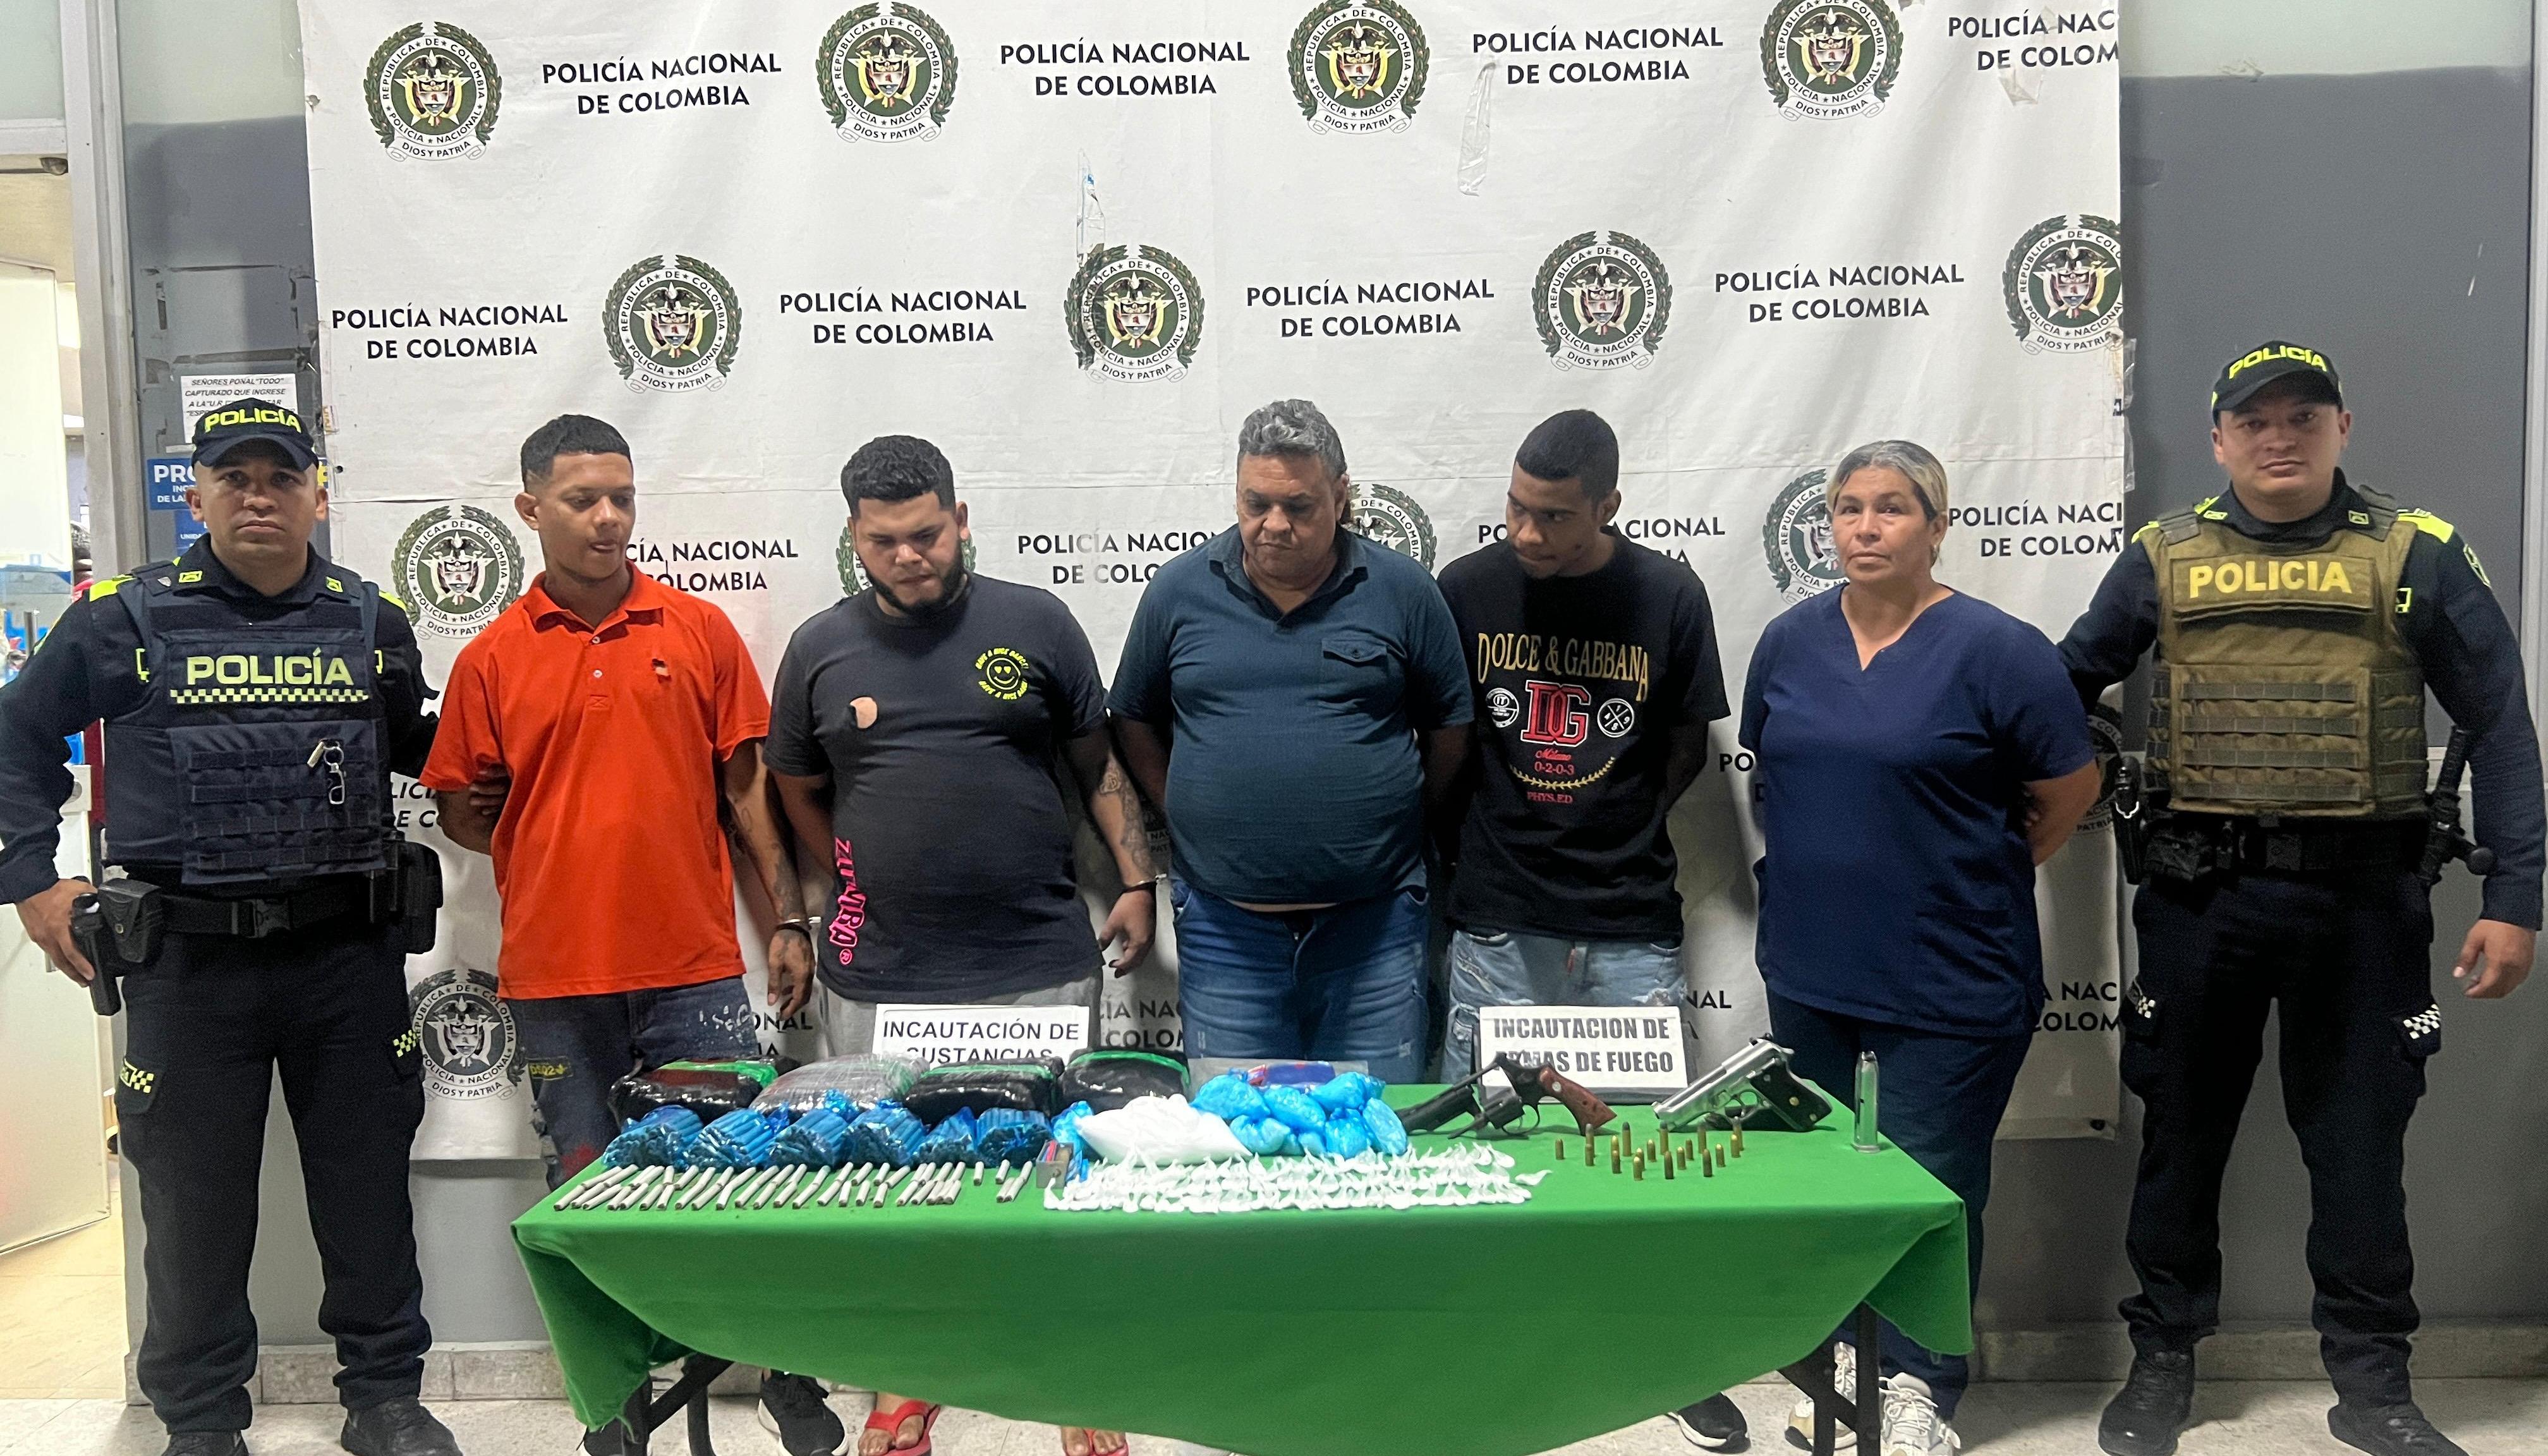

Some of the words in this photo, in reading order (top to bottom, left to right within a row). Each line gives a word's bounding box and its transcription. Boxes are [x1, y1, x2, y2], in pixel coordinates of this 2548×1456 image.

[1778, 3, 1814, 58] REPUBLICA
[1852, 1, 1884, 55] COLOMBIA
[1949, 9, 2048, 38] POLICÍA
[834, 24, 870, 79] REPUBLICA
[907, 24, 940, 79] COLOMBIA
[1001, 37, 1104, 64] POLICÍA
[1113, 42, 1249, 63] NACIONAL
[1306, 16, 1342, 71] REPUBLICA
[1352, 9, 1366, 18] DE
[1378, 15, 1412, 70] COLOMBIA
[1474, 25, 1576, 52] POLICÍA
[1586, 27, 1723, 49] NACIONAL
[543, 56, 640, 83] POLICÍA
[652, 53, 781, 79] NACIONAL
[1978, 50, 2010, 70] DE
[2021, 41, 2119, 67] COLOM
[382, 45, 415, 99] REPUBLICA
[451, 44, 485, 98] COLOMBIA
[1036, 76, 1067, 95] DE
[1077, 75, 1216, 95] COLOMBIA
[1508, 64, 1539, 84] DE
[1550, 60, 1689, 83] COLOMBIA
[1783, 71, 1819, 102] POLICIA
[1833, 68, 1879, 103] NACIONAL
[578, 95, 609, 114] DE
[619, 86, 749, 112] COLOMBIA
[840, 92, 877, 124] POLICIA
[890, 92, 936, 126] NACIONAL
[1311, 84, 1347, 116] POLICIA
[1361, 83, 1407, 118] NACIONAL
[1795, 100, 1820, 116] DIOS
[1831, 99, 1869, 116] PATRIA
[389, 112, 424, 143] POLICIA
[437, 111, 481, 145] NACIONAL
[854, 123, 878, 138] DIOS
[890, 123, 926, 139] PATRIA
[1324, 114, 1349, 130] DIOS
[1360, 114, 1396, 131] PATRIA
[402, 142, 426, 157] DIOS
[437, 141, 471, 157] PATRIA
[2019, 237, 2056, 292] REPUBLICA
[2068, 230, 2083, 238] DE
[1550, 253, 1586, 308] REPUBLICA
[1623, 253, 1654, 307] COLOMBIA
[1716, 264, 1820, 292] POLICÍA
[1830, 264, 1963, 286] NACIONAL
[621, 277, 655, 331] REPUBLICA
[692, 277, 725, 331] COLOMBIA
[781, 287, 882, 313] POLICÍA
[892, 290, 1026, 312] NACIONAL
[1155, 267, 1187, 320] COLOMBIA
[1247, 279, 1349, 306] POLICÍA
[1358, 279, 1494, 303] NACIONAL
[332, 303, 431, 329] POLICÍA
[440, 305, 567, 326] NACIONAL
[1750, 303, 1781, 322] DE
[1792, 298, 1929, 320] COLOMBIA
[2025, 305, 2060, 335] POLICIA
[814, 325, 846, 343] DE
[856, 323, 993, 344] COLOMBIA
[1282, 318, 1313, 337] DE
[1323, 313, 1460, 336] COLOMBIA
[1555, 321, 1590, 352] POLICIA
[1603, 320, 1649, 354] NACIONAL
[368, 341, 397, 359] DE
[407, 337, 537, 358] COLOMBIA
[1089, 334, 1124, 365] POLICIA
[1138, 334, 1183, 367] NACIONAL
[2037, 334, 2061, 349] DIOS
[628, 344, 664, 375] POLICIA
[677, 343, 722, 376] NACIONAL
[1101, 363, 1125, 379] DIOS
[1137, 363, 1173, 380] PATRIA
[1567, 351, 1591, 367] DIOS
[1603, 351, 1638, 367] PATRIA
[185, 389, 233, 397] CAPTURADO
[191, 378, 228, 386] SEÑORES
[641, 373, 666, 389] DIOS
[677, 373, 712, 389] PATRIA
[157, 495, 170, 503] DE
[1781, 490, 1816, 545] REPUBLICA
[1948, 500, 2048, 526] POLICÍA
[2058, 502, 2121, 523] NACI
[1018, 528, 1119, 554] POLICÍA
[1127, 531, 1220, 553] NACIO
[1387, 505, 1419, 558] COLOMBIA
[1613, 516, 1725, 539] CIONAL
[409, 526, 442, 579] REPUBLICA
[476, 526, 507, 578] COLOMBIA
[672, 540, 798, 561] NACIONAL
[1981, 538, 2011, 557] DE
[2020, 534, 2121, 557] COLOM
[645, 571, 768, 592] OLOMBIA
[1053, 565, 1084, 584] DE
[1786, 557, 1819, 587] POLICIA
[2189, 561, 2353, 598] POLICIA
[415, 592, 448, 621] POLICIA
[461, 591, 504, 623] NACIONAL
[427, 620, 450, 635] DIOS
[186, 646, 354, 686] POLICÍA
[1477, 633, 1542, 684] DOLCE
[1544, 636, 1563, 676] &
[1563, 638, 1649, 702] GABBANA
[1520, 679, 1592, 748] DG
[1534, 761, 1575, 776] 0-2-0-3
[482, 990, 515, 1042] COLOMBIA
[883, 1017, 1041, 1040] INCAUTACIÓN
[1049, 1023, 1079, 1040] DE
[1493, 1017, 1638, 1040] INCAUTACION
[1643, 1017, 1670, 1040] DE
[420, 1052, 455, 1082] POLICIA
[468, 1054, 511, 1084] NACIONAL
[1575, 1051, 1603, 1072] DE
[1606, 1050, 1674, 1073] FUEGO
[434, 1080, 458, 1095] DIOS
[468, 1082, 502, 1096] PATRIA
